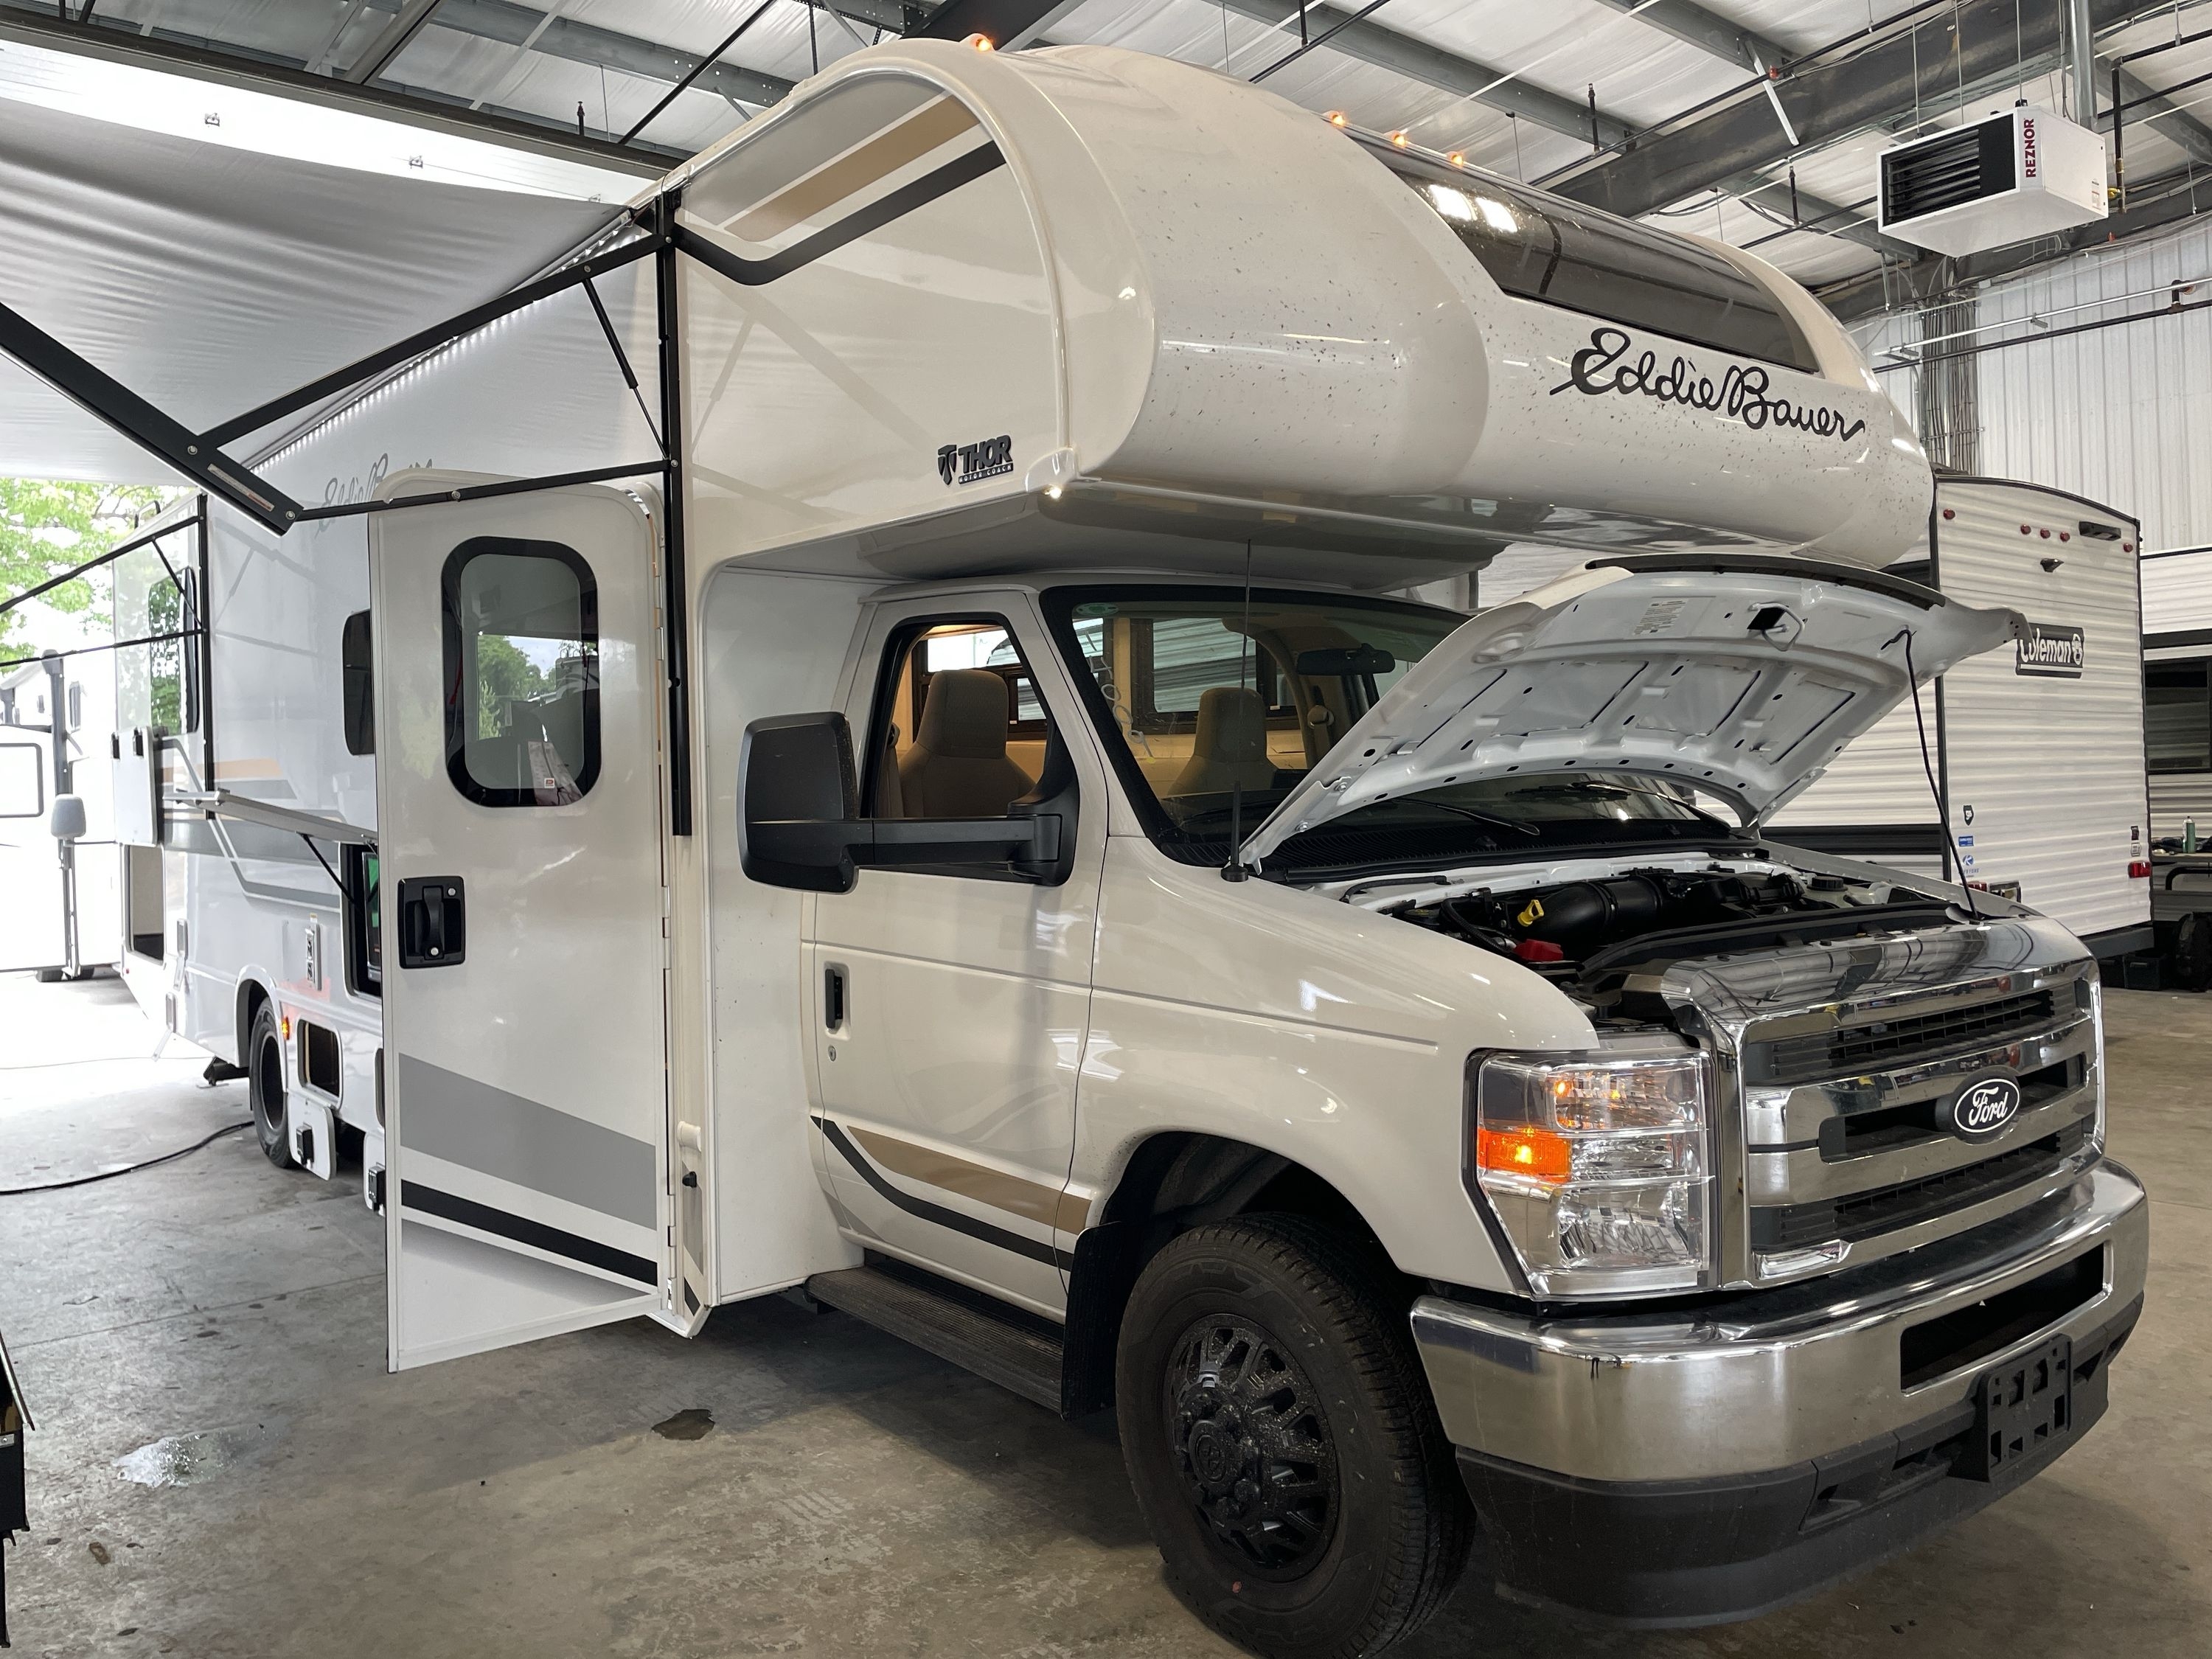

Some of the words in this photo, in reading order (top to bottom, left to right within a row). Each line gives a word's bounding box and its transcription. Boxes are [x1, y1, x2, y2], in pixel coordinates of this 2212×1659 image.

[2023, 118, 2037, 178] REZNOR
[1549, 327, 1720, 411] Eddie
[1718, 364, 1865, 442] Bauer
[958, 435, 1013, 474] THOR
[959, 472, 983, 483] MOTOR
[987, 464, 1012, 476] COACH
[1968, 1086, 2008, 1126] Ford
